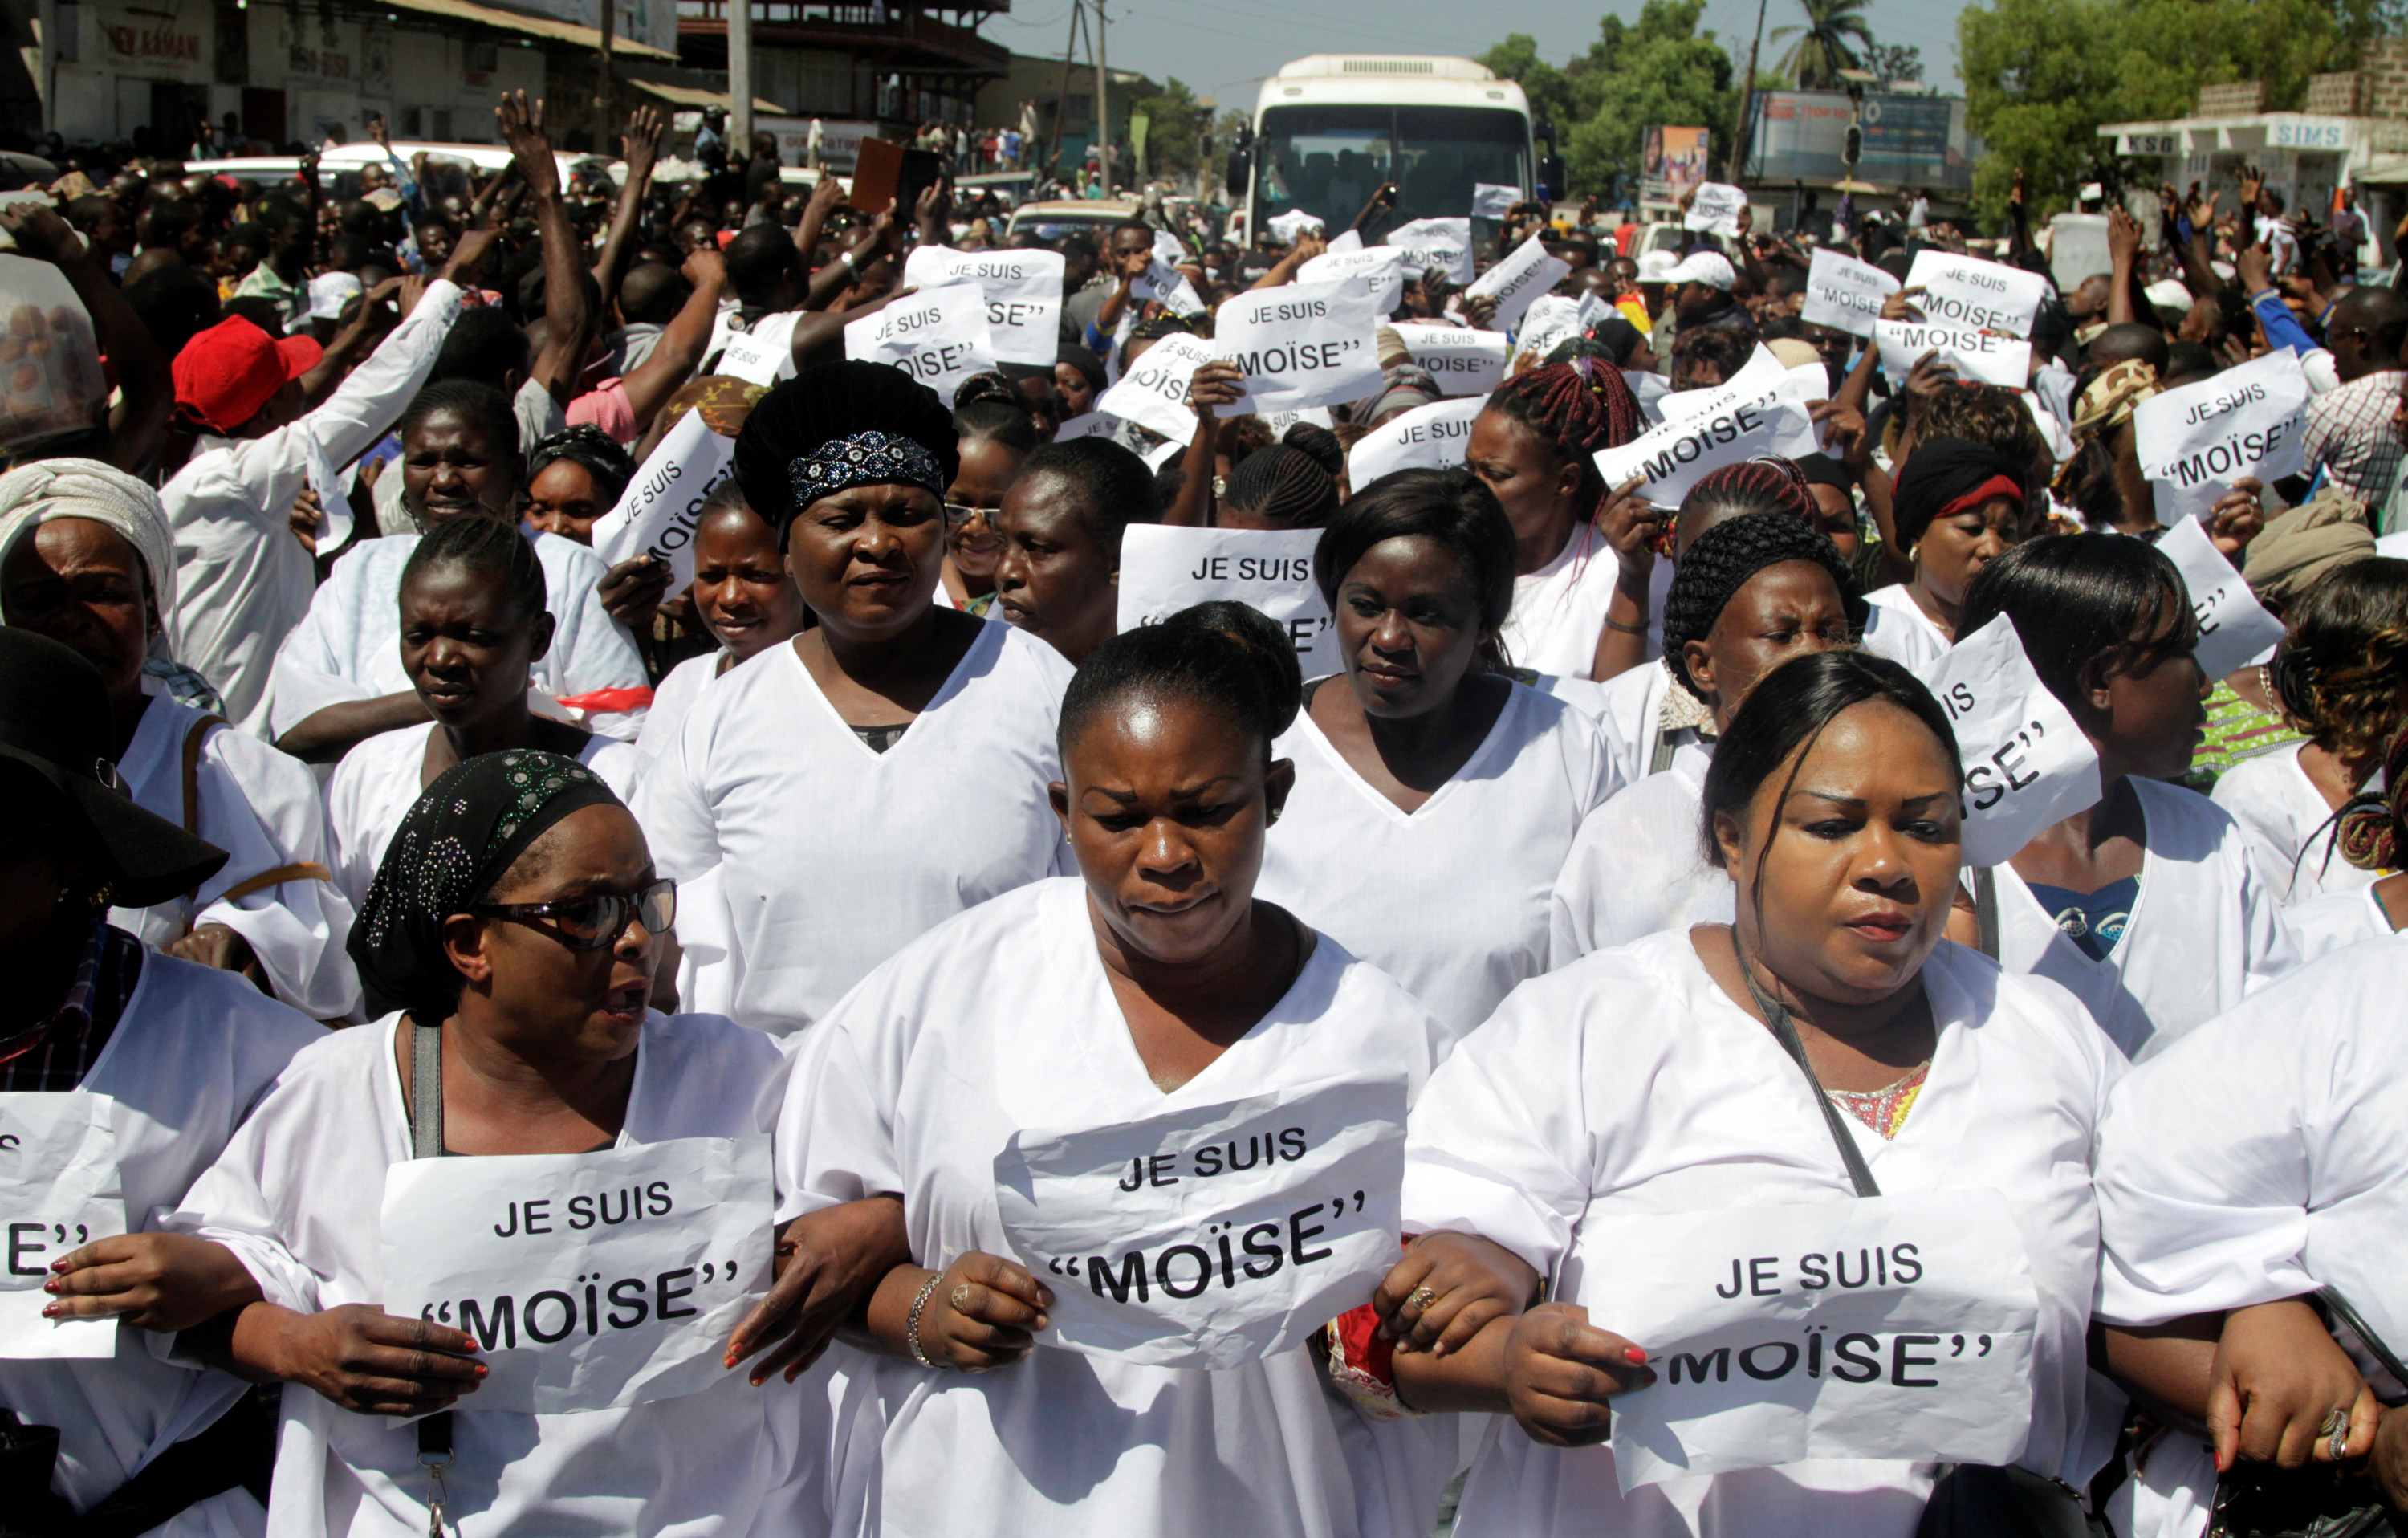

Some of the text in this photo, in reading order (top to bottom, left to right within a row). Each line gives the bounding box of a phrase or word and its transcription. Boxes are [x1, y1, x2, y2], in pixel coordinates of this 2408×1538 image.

[2278, 125, 2341, 145] SIMS
[950, 263, 1022, 279] JE SUIS
[1946, 268, 2007, 292] JE SUIS
[875, 307, 942, 341] JE SUIS
[1249, 301, 1326, 324] JE SUIS
[1421, 333, 1475, 344] JE SUIS
[2186, 383, 2265, 425] JE SUIS
[1273, 409, 1300, 431] SUIS
[1398, 418, 1475, 445] JE SUI
[624, 460, 682, 526] JE SUIS
[1191, 557, 1310, 582] JE SUIS
[1118, 1126, 1308, 1193] JE SUIS
[493, 1180, 673, 1239] JE SUIS
[1715, 1243, 1923, 1299] JE SUIS
